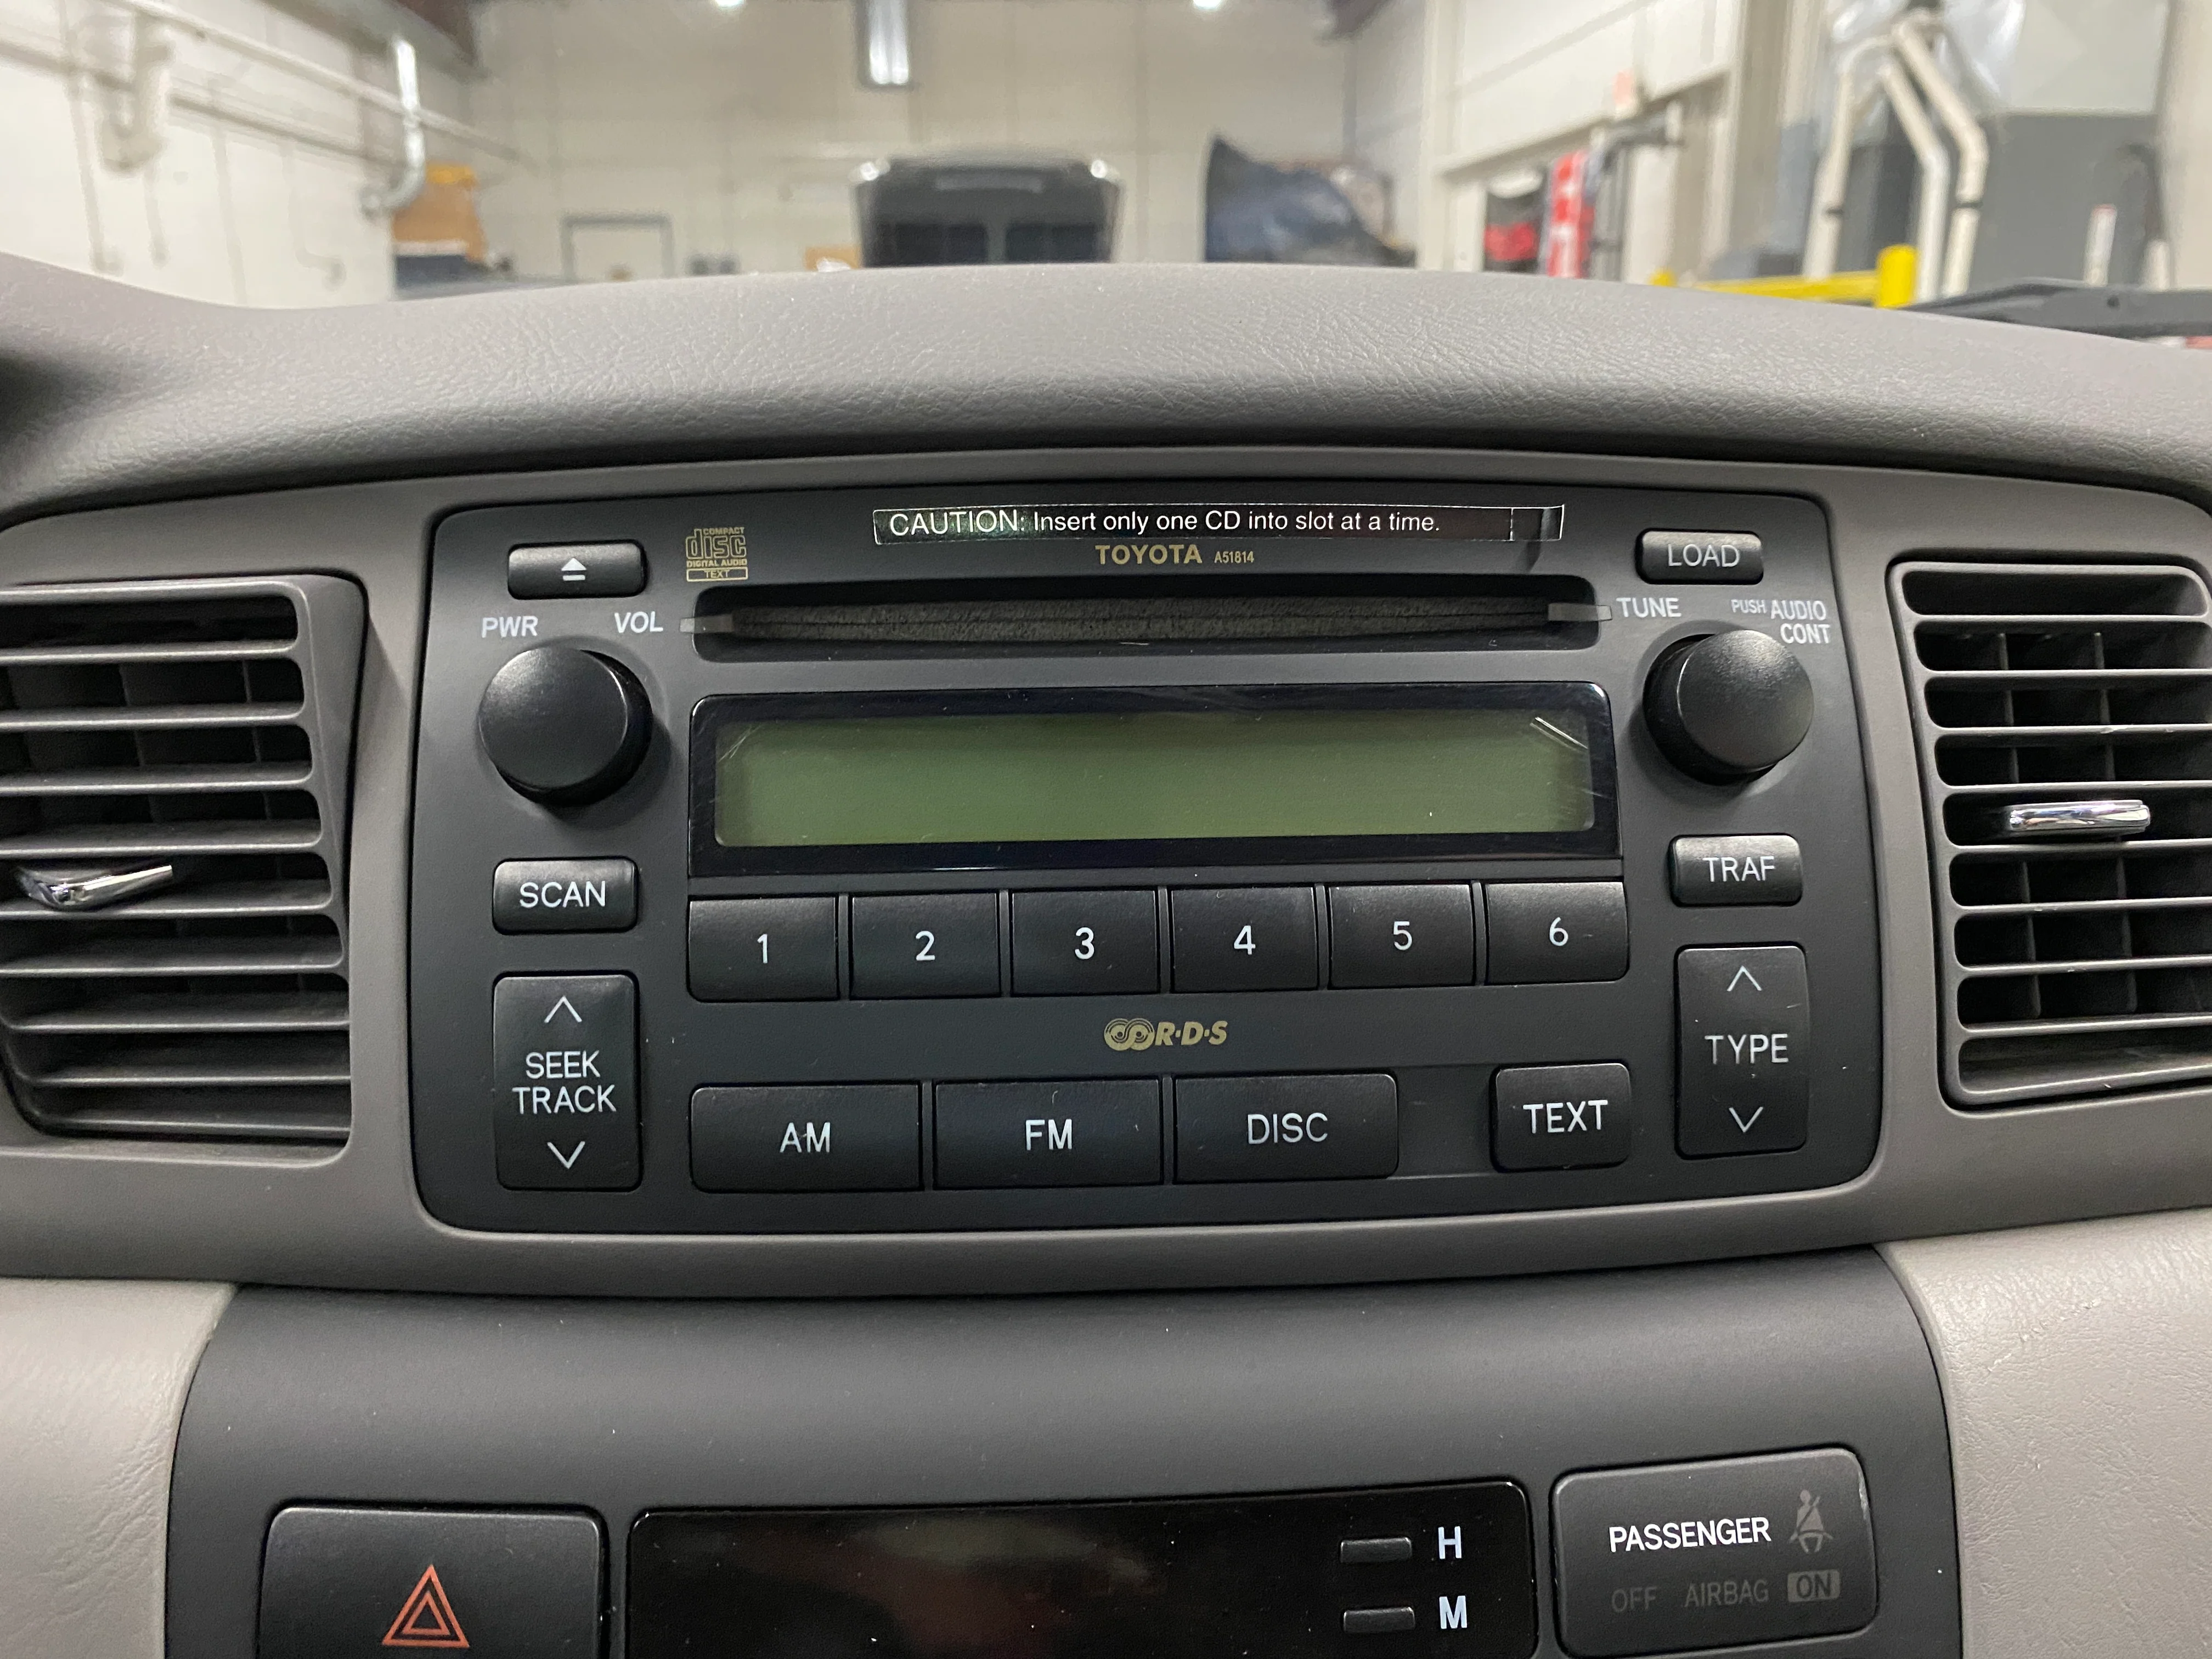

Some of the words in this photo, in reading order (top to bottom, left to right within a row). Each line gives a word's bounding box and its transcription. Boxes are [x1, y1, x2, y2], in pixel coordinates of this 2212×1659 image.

[703, 527, 744, 535] COMPACT
[890, 509, 1025, 536] CAUTION:
[1034, 511, 1096, 531] Insert
[1103, 511, 1149, 535] only
[1156, 515, 1198, 530] one
[1205, 510, 1240, 530] CD
[1249, 511, 1288, 530] into
[1295, 511, 1334, 530] slot
[1341, 513, 1361, 531] at
[1368, 516, 1381, 531] a
[1389, 512, 1440, 531] time.
[686, 560, 720, 568] DIGITAL
[1095, 544, 1203, 565] TOYOTA
[1214, 551, 1255, 563] A51814
[1667, 544, 1740, 567] LOAD
[704, 569, 730, 578] TEXT
[614, 611, 663, 633] VOL
[1616, 597, 1681, 618] TUNE
[1731, 599, 1767, 614] PUSH
[1770, 600, 1826, 620] AUDIO
[482, 616, 538, 638] PWR
[1780, 623, 1831, 644] CONT
[1703, 856, 1775, 882] TRAF
[520, 881, 606, 908] SCAN
[916, 930, 935, 961] 2
[1074, 927, 1094, 960] 3
[1234, 925, 1256, 955] 4
[1392, 921, 1413, 951] 5
[1549, 917, 1568, 947] 6
[757, 933, 769, 963] 1
[1705, 1033, 1789, 1065] TYPE
[526, 1050, 601, 1080] SEEK
[512, 1084, 617, 1114] TRACK
[1247, 1113, 1328, 1144] DISC
[1523, 1099, 1609, 1134] TEXT
[780, 1122, 831, 1153] AM
[1025, 1119, 1073, 1151] FM
[1437, 1526, 1462, 1560] H
[1609, 1516, 1772, 1553] PASSENGER
[1611, 1585, 1658, 1613] OFF
[1684, 1579, 1769, 1607] AIRBAG
[1796, 1572, 1832, 1598] ON
[1438, 1595, 1468, 1629] M
